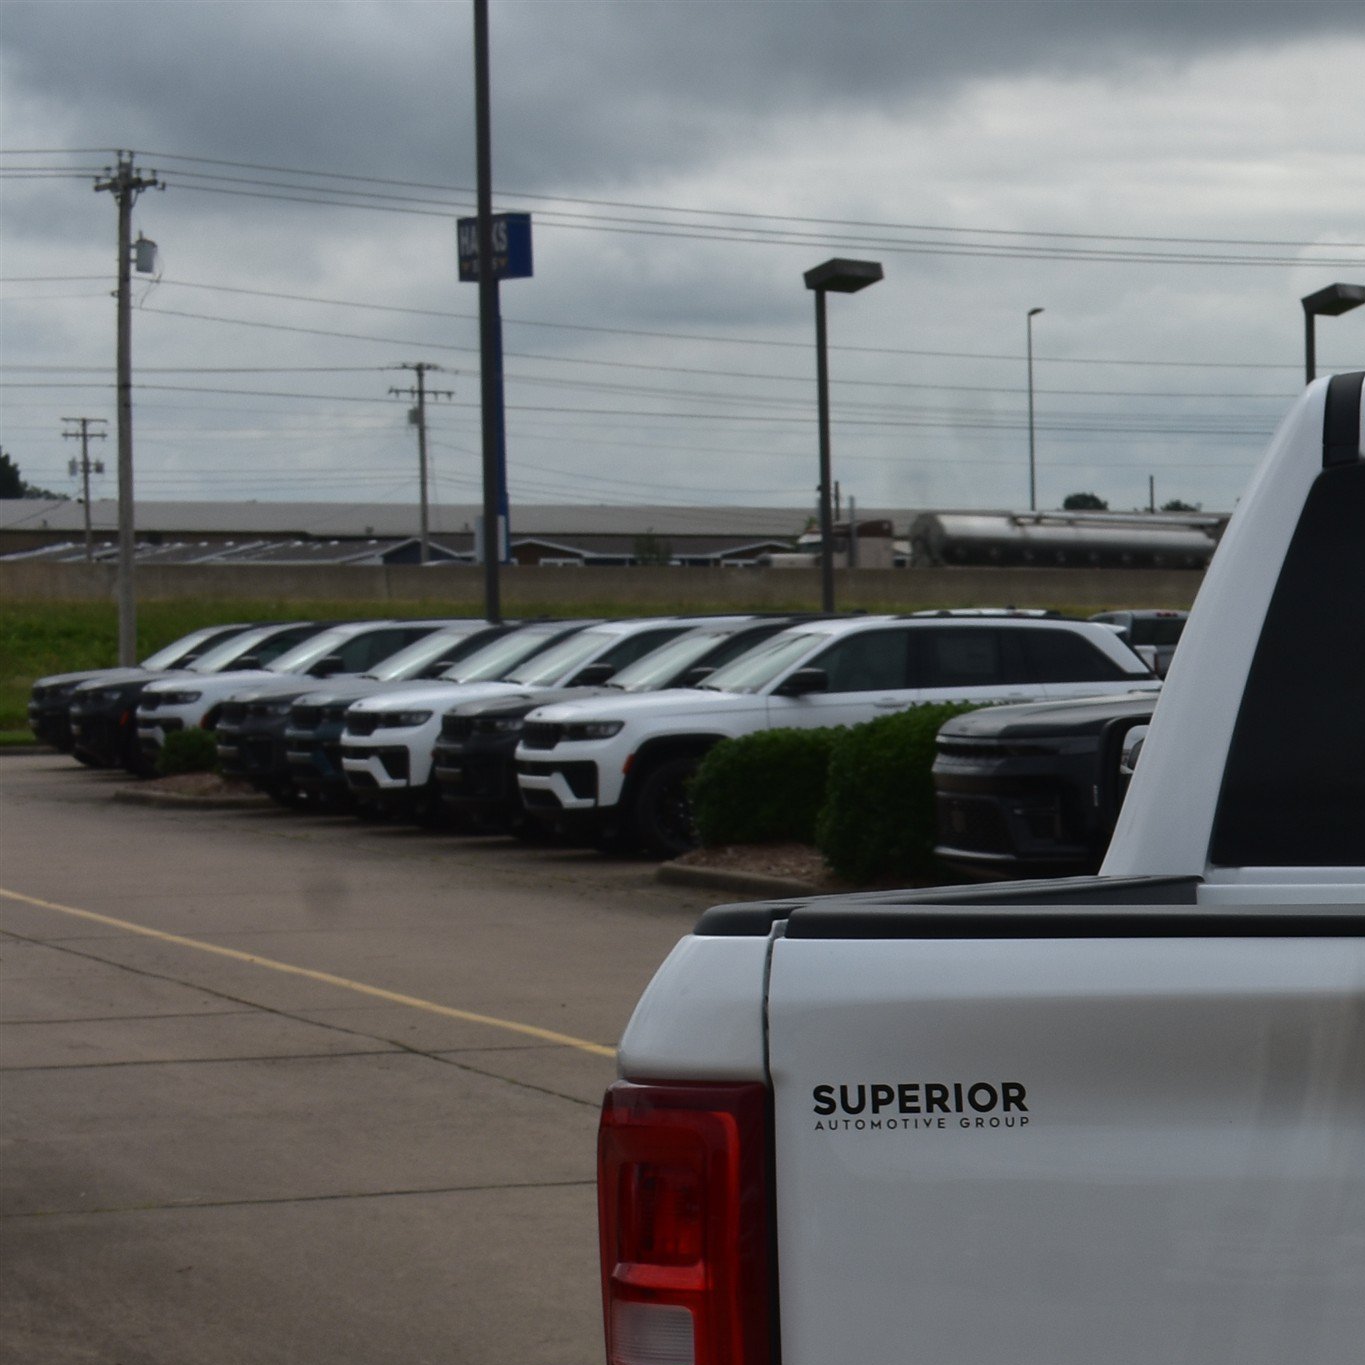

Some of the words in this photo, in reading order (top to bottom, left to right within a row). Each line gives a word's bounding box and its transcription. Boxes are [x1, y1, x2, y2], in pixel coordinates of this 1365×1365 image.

[812, 1082, 1029, 1115] SUPERIOR
[814, 1117, 947, 1131] AUTOMOTIVE
[960, 1116, 1029, 1129] GROUP
